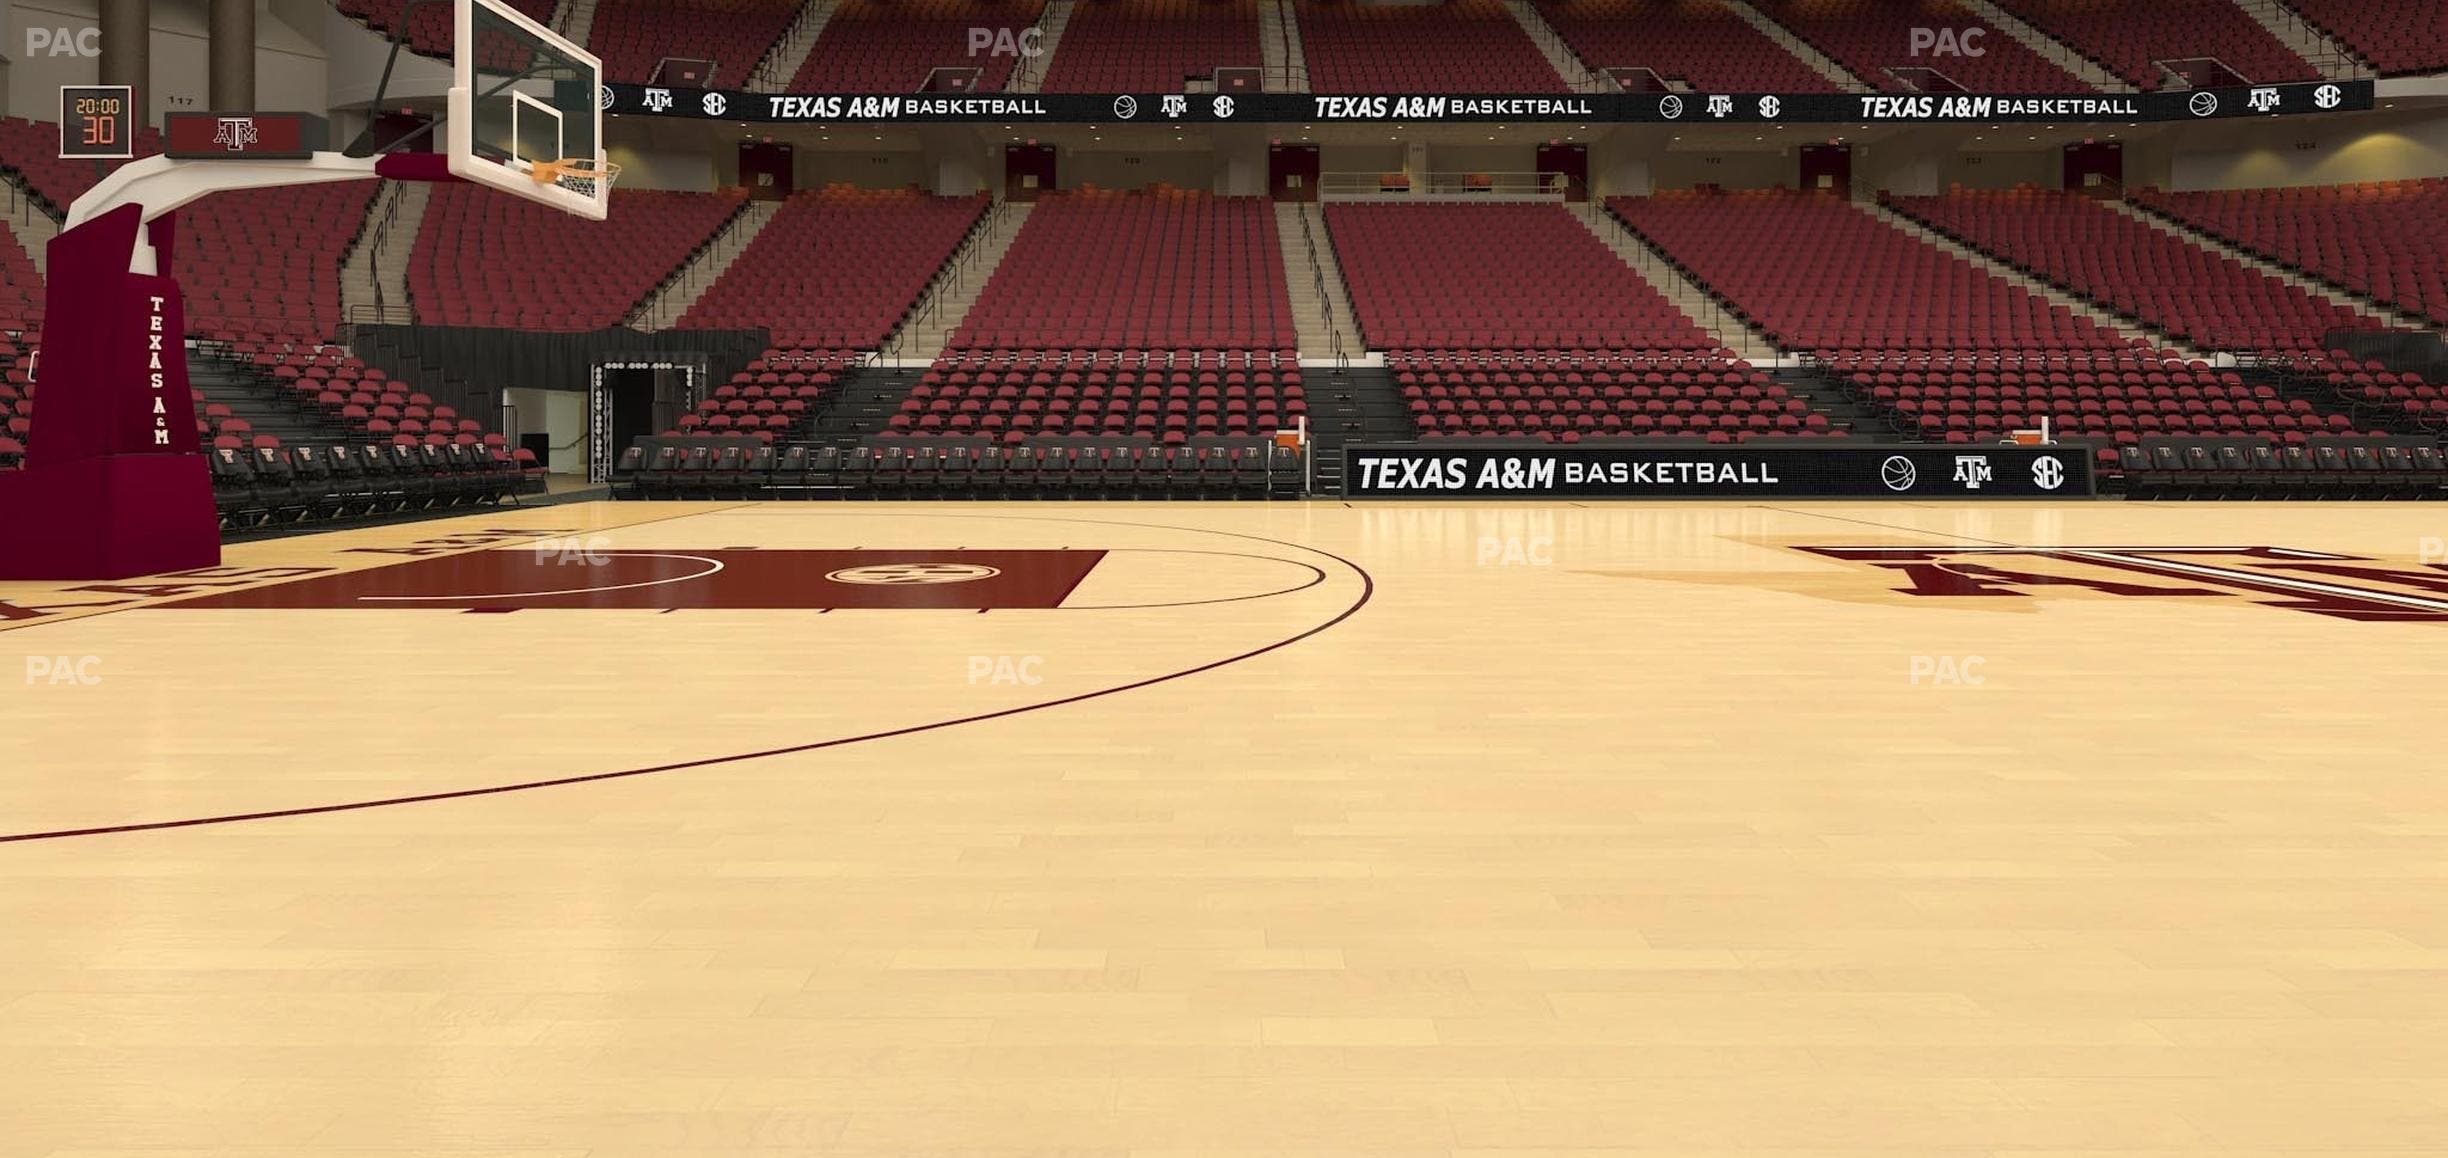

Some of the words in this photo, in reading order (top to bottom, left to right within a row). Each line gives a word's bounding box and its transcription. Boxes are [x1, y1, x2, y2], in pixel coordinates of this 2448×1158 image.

[76, 98, 120, 115] 20:00
[169, 95, 193, 106] 117
[702, 92, 727, 116] SEC
[769, 96, 842, 118] TEXAS
[846, 96, 901, 118] A&M
[905, 98, 1047, 115] BASKETBALL
[1212, 95, 1235, 119] SEC
[1315, 96, 1388, 118] TEXAS
[1392, 96, 1447, 118] A&M
[1451, 98, 1593, 115] BASKETBALL
[1758, 95, 1781, 118] SEC
[1860, 96, 1933, 118] TEXAS
[1937, 96, 1992, 118] A&M
[1996, 98, 2138, 115] BASKETBALL
[2313, 84, 2342, 109] SEC
[83, 115, 115, 145] 30
[149, 296, 165, 388] TEXAS
[153, 396, 170, 445] A&M
[1358, 457, 1468, 490] TEXAS
[1475, 457, 1556, 490] A&M
[1565, 461, 1779, 484] BASKETBALL
[2031, 455, 2065, 490] SEC
